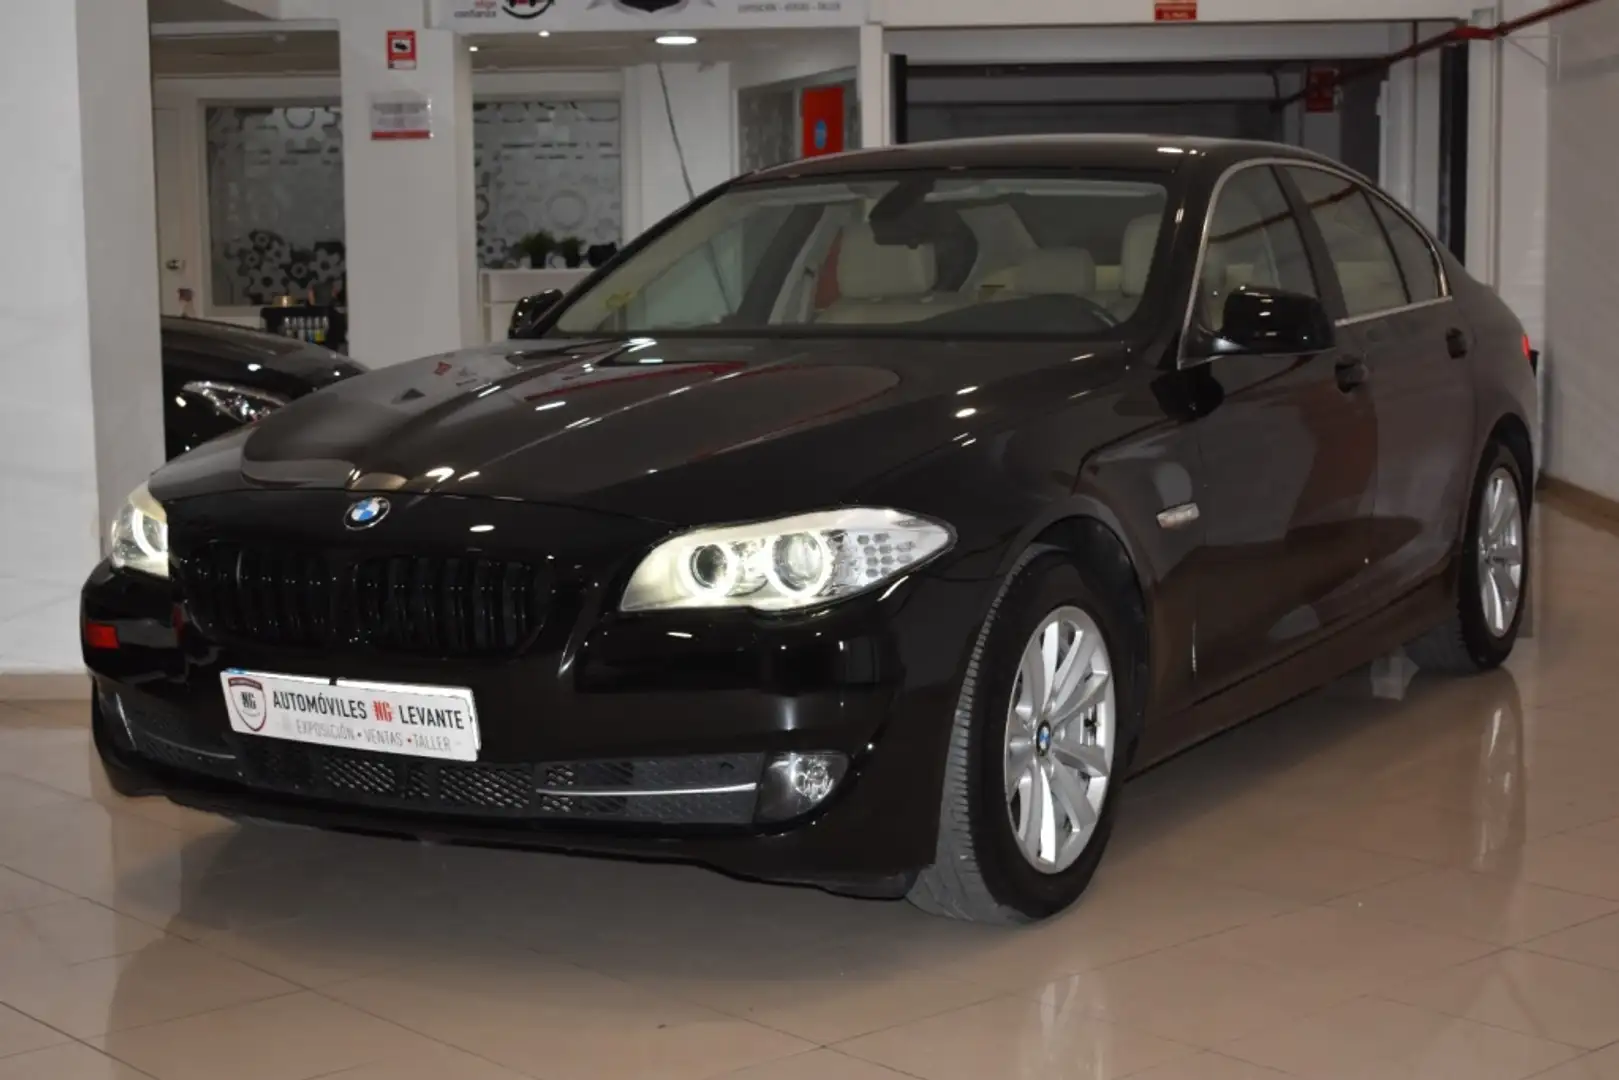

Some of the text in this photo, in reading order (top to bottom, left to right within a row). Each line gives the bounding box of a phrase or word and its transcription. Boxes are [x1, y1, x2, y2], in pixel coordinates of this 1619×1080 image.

[273, 691, 367, 720] AUTOMÓVILES
[398, 705, 464, 730] LEVANTE
[296, 719, 451, 752] EXPOSICIÓN VENTAS TALLER
